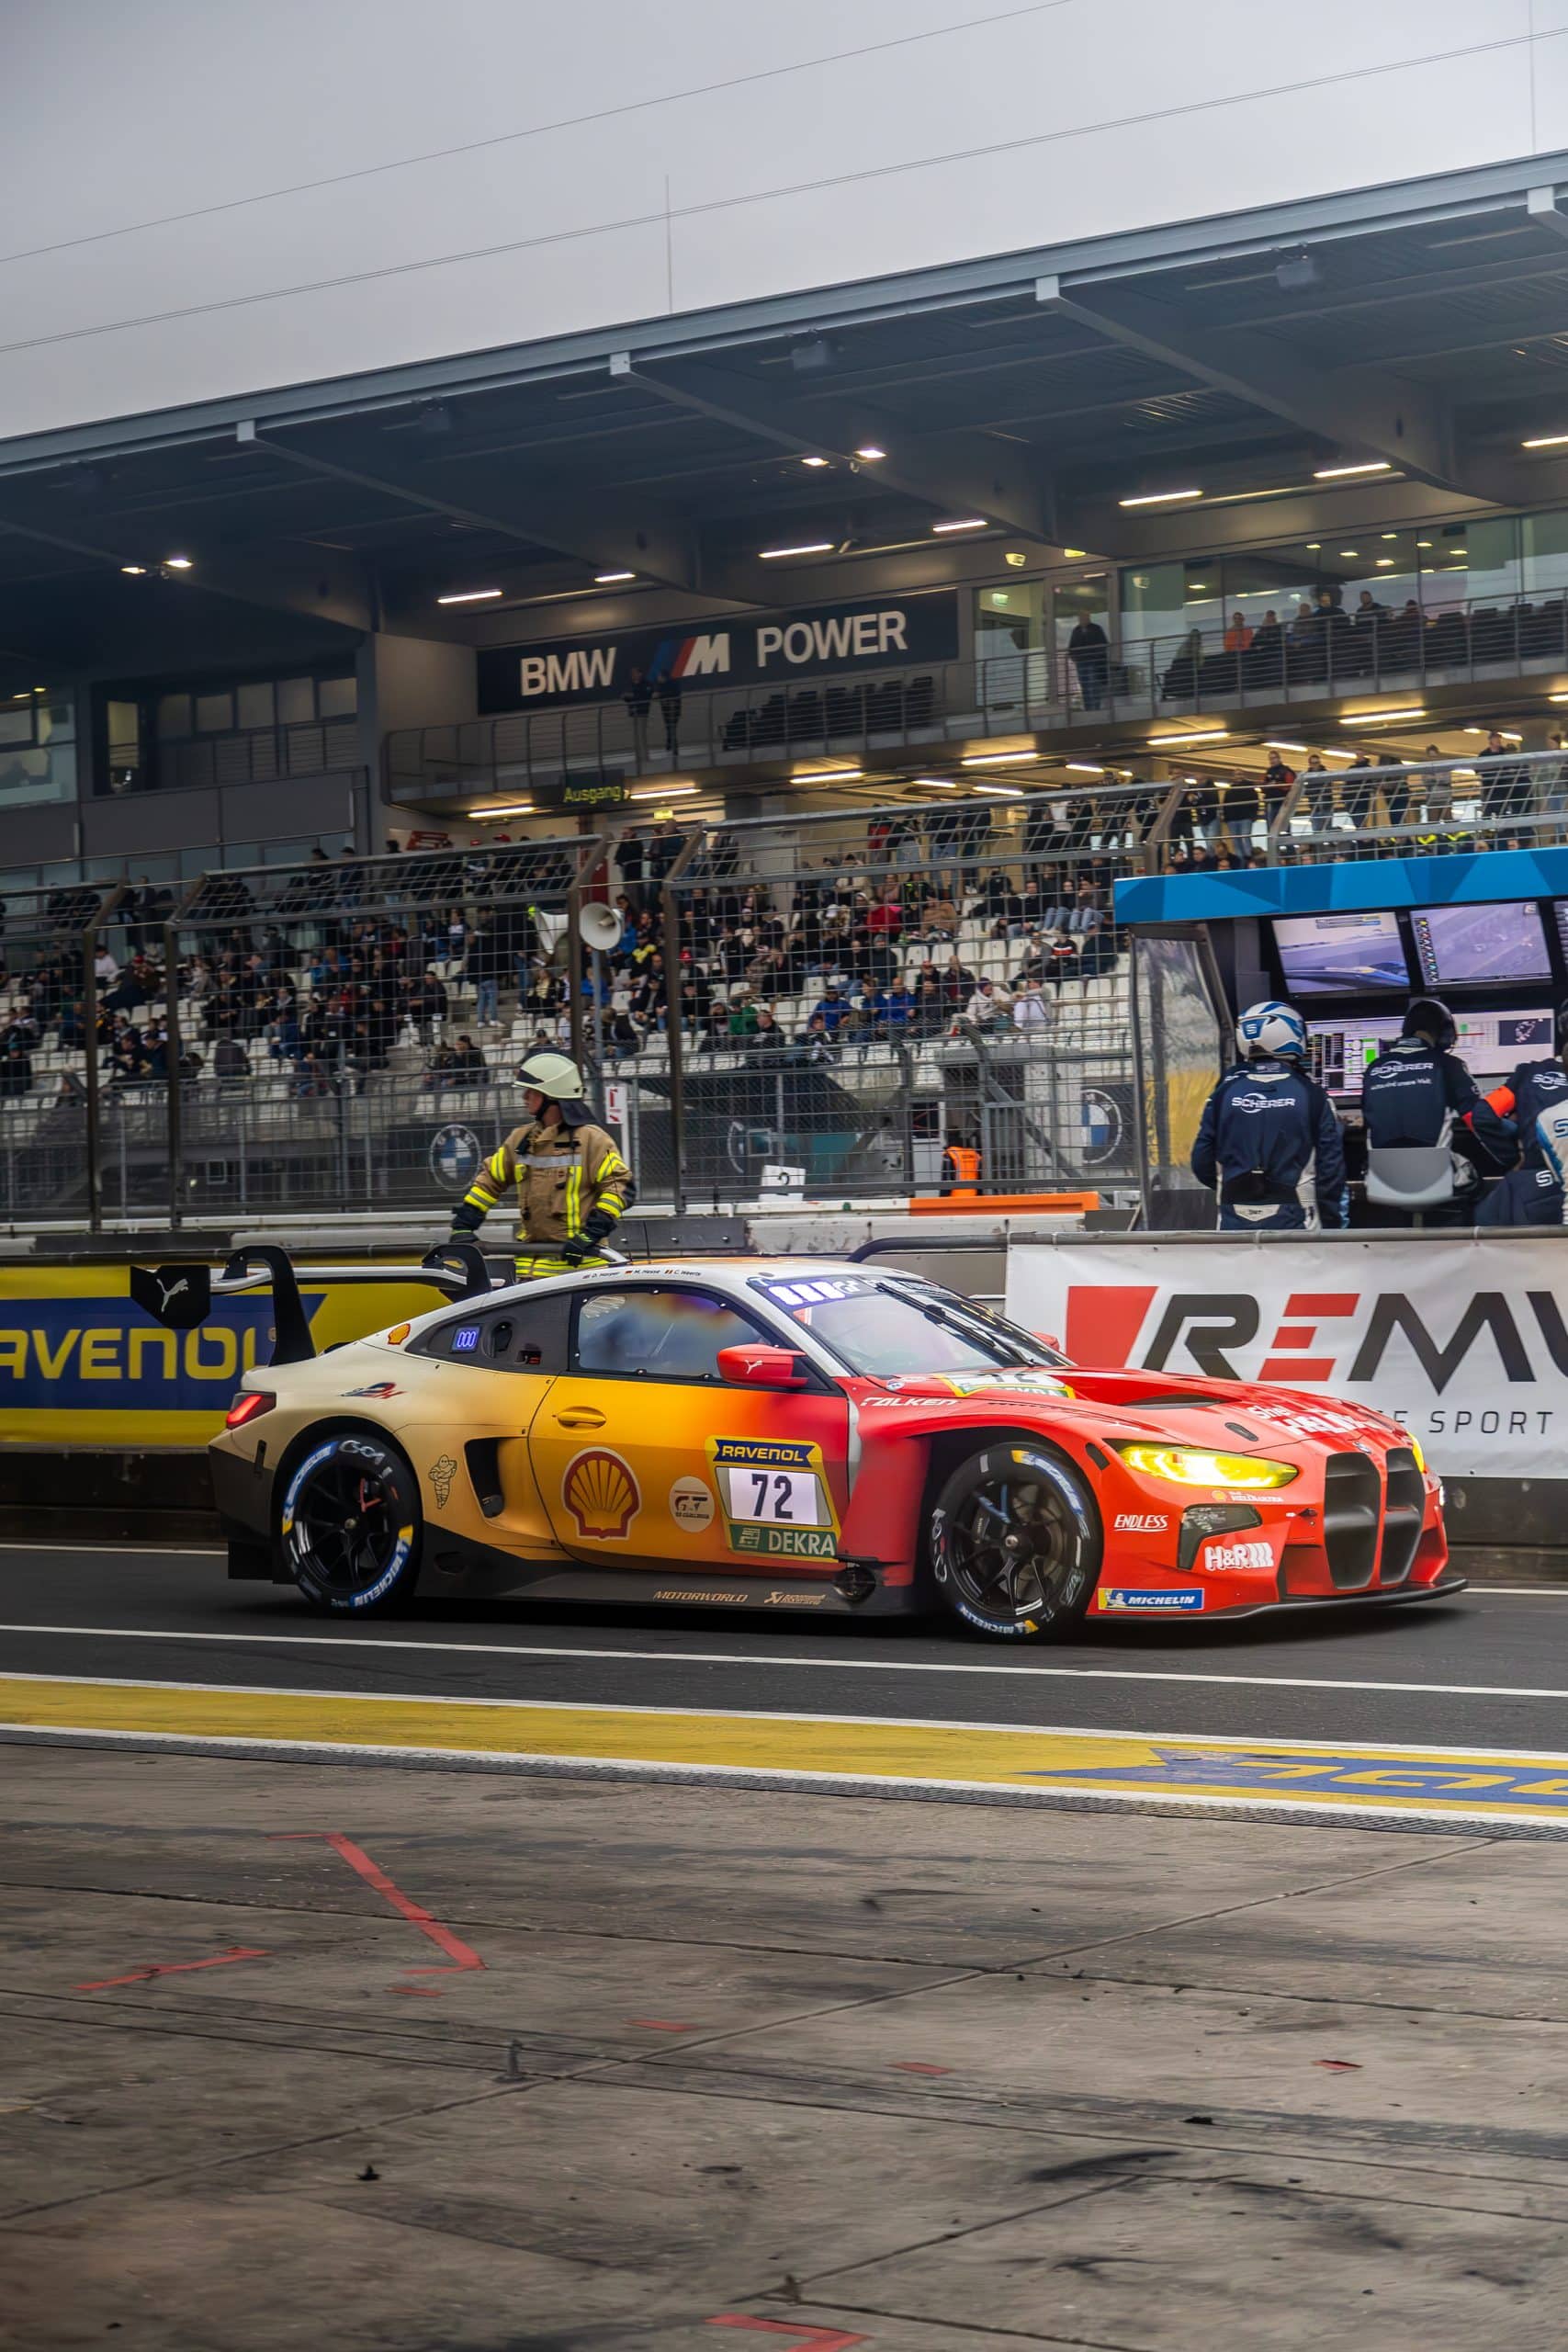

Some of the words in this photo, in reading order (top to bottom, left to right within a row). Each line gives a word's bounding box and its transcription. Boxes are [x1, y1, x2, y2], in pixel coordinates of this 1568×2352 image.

[520, 647, 615, 696] BMW
[683, 632, 730, 677] M
[757, 610, 908, 668] POWER
[564, 782, 623, 804] Ausgang
[1371, 1062, 1434, 1076] SCHERER
[1532, 1073, 1568, 1086] SCHE
[1231, 1096, 1296, 1109] SCHERER
[860, 1396, 959, 1408] FALKEN
[1429, 1410, 1553, 1434] SPORT
[722, 1446, 805, 1462] RAVENOL
[751, 1473, 794, 1520] 72
[1114, 1514, 1169, 1529] ENDLESS
[768, 1530, 836, 1556] DEKRA
[1204, 1544, 1249, 1571] H&R
[653, 1590, 749, 1603] MOTORWORLD
[1128, 1596, 1195, 1605] MICHELIN
